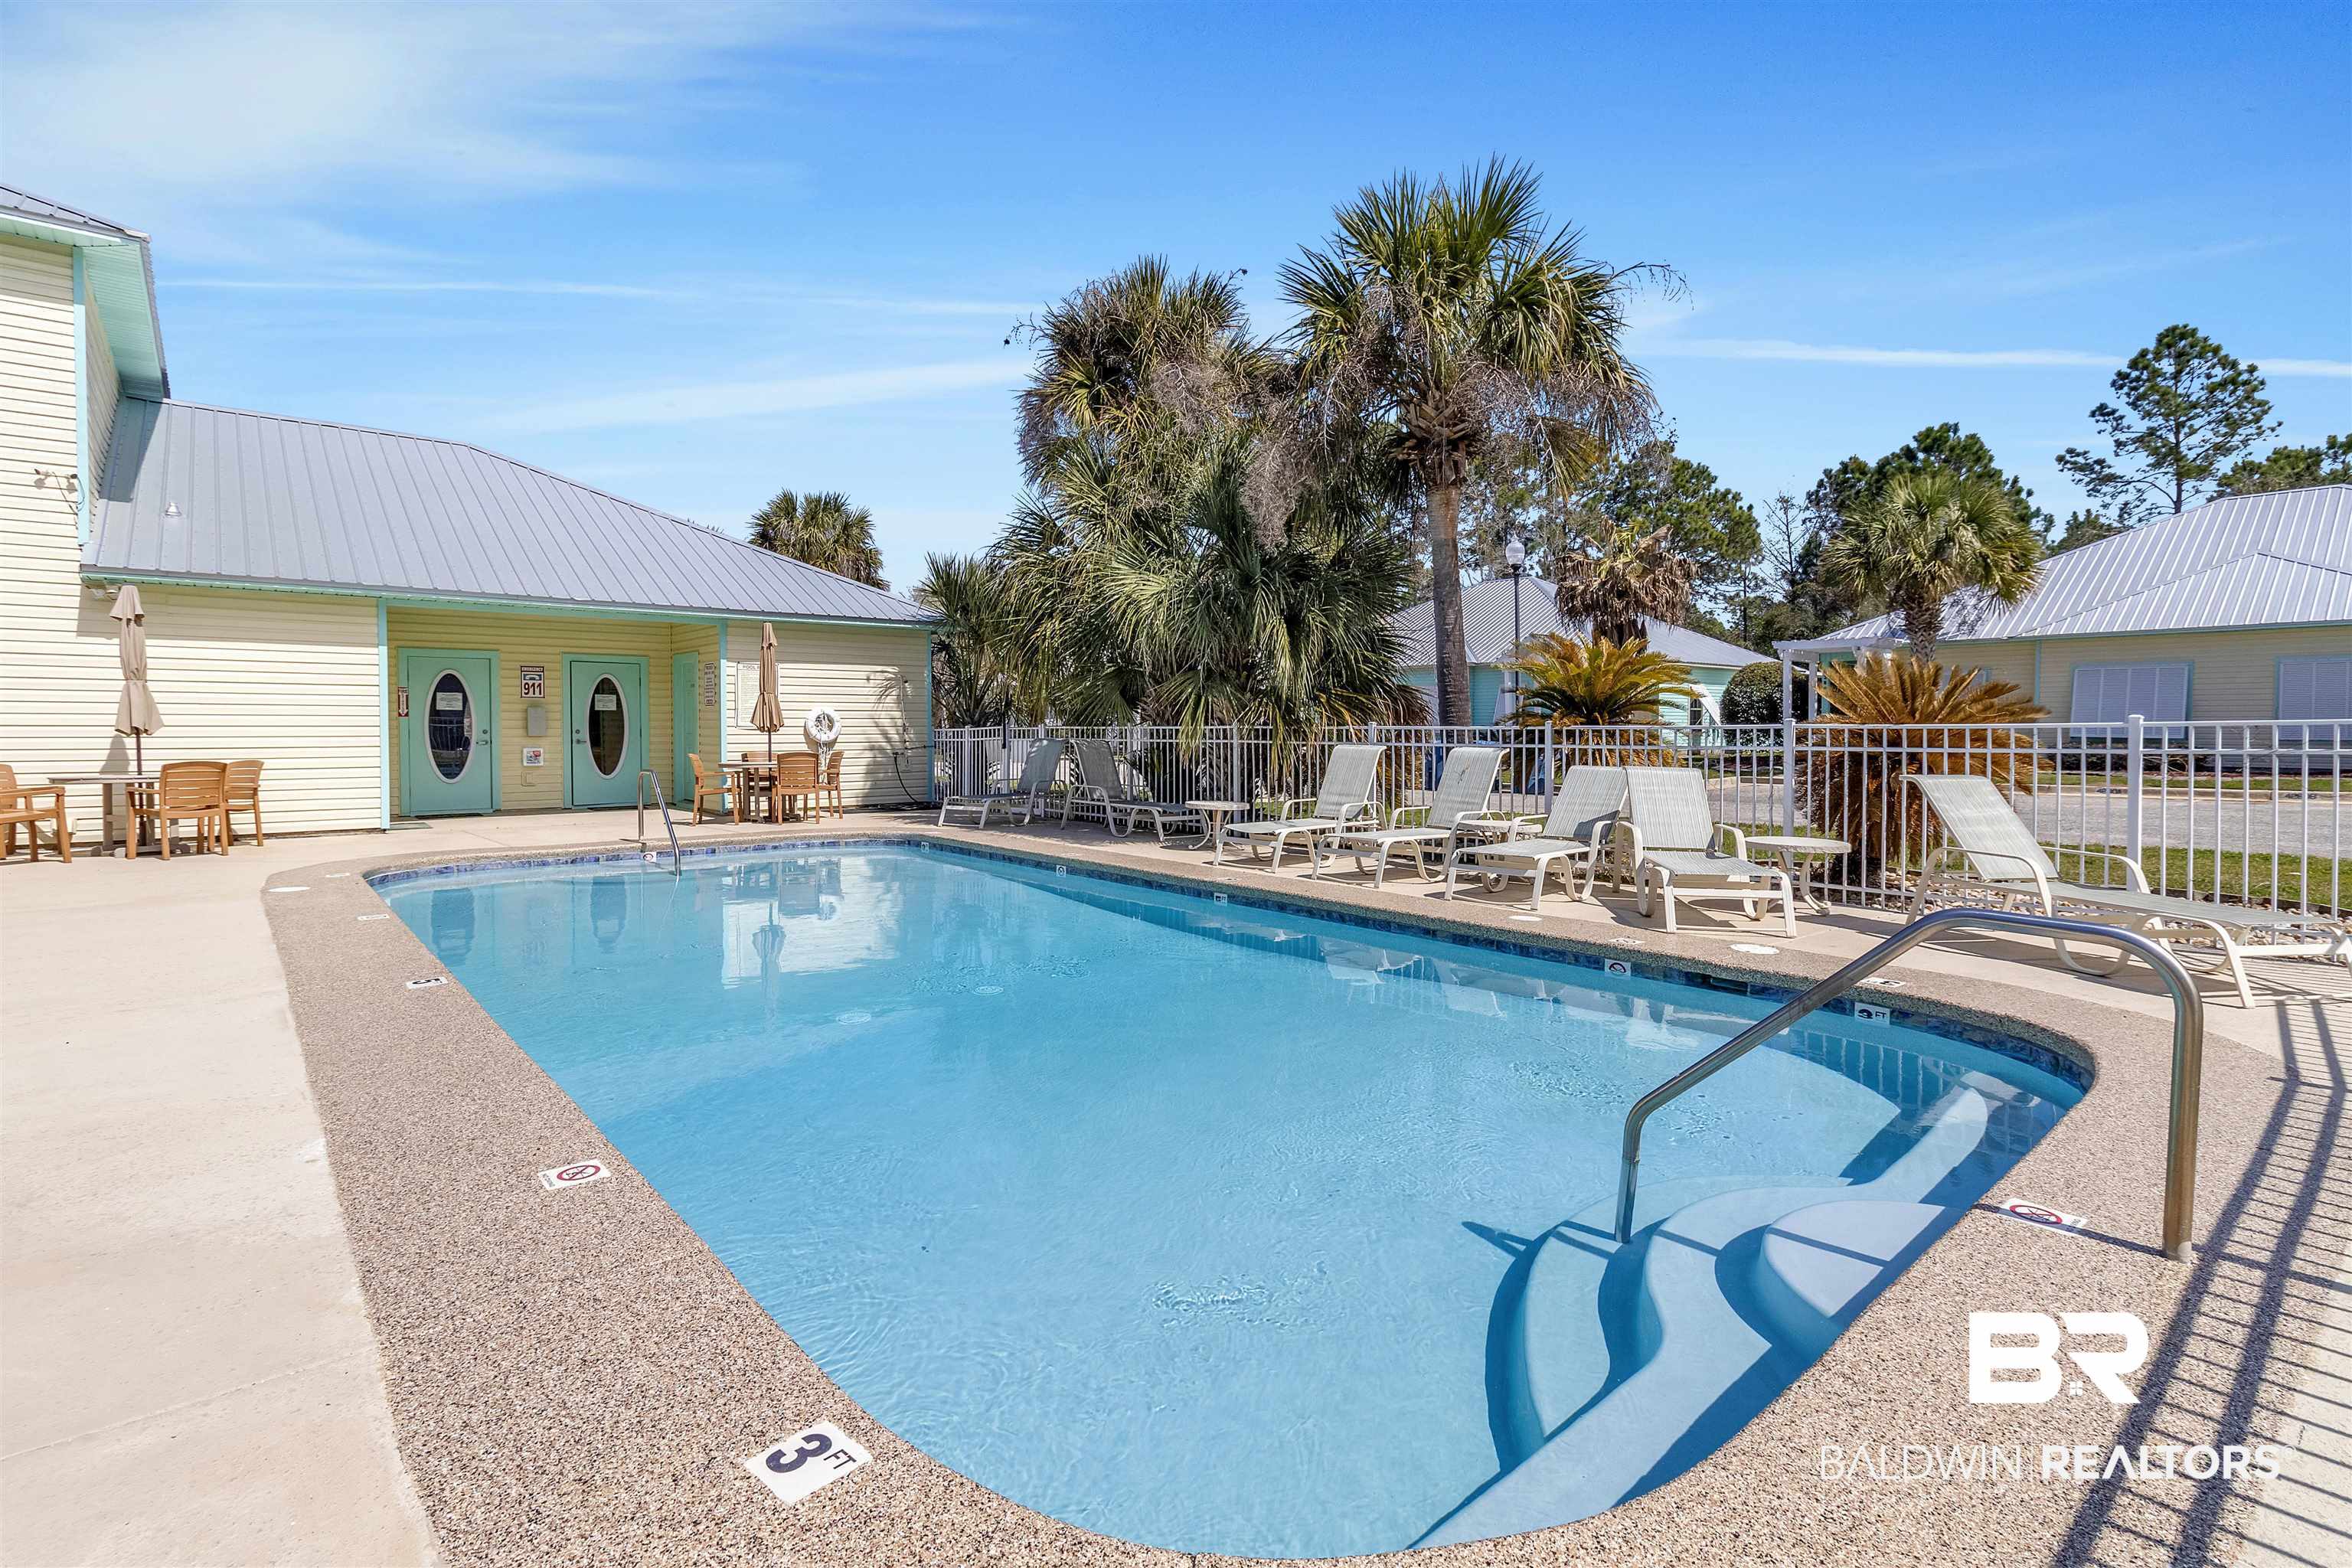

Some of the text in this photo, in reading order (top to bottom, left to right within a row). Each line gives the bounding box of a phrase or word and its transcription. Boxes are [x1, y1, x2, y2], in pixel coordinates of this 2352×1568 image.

[524, 682, 542, 695] 911
[1875, 1011, 1887, 1019] FT
[766, 1433, 857, 1473] 3 FT
